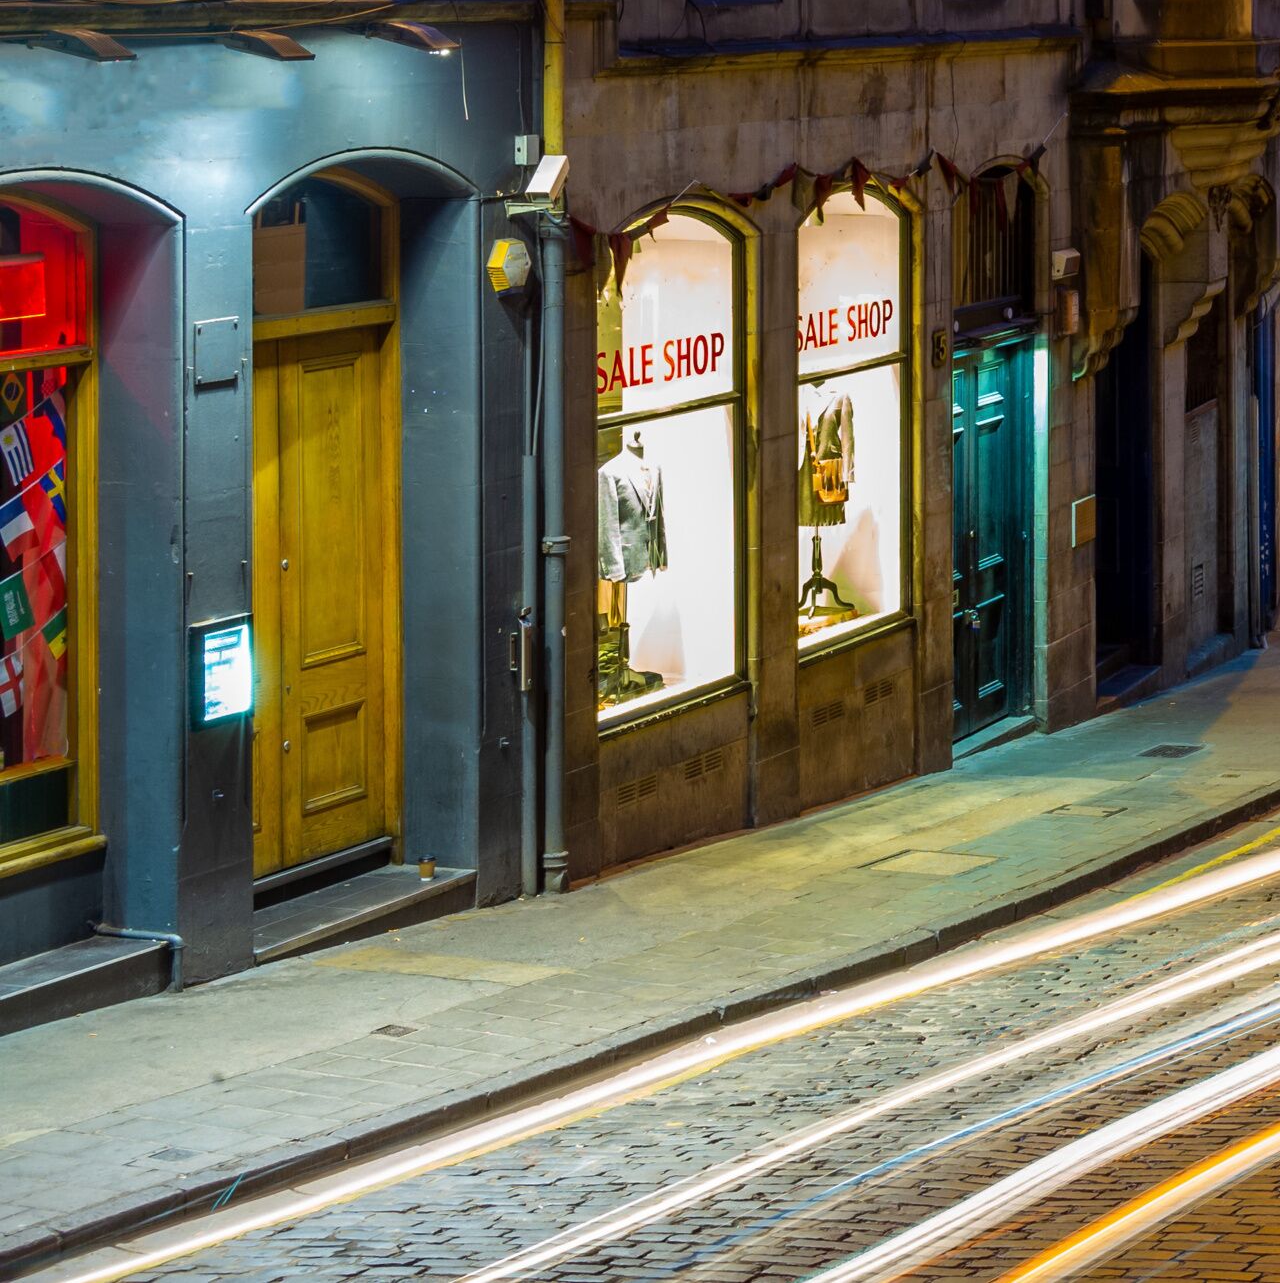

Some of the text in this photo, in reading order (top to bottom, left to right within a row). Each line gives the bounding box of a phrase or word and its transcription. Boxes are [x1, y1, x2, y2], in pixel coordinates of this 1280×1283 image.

[796, 299, 893, 354] SALE SHOP
[597, 332, 724, 395] SALE SHOP
